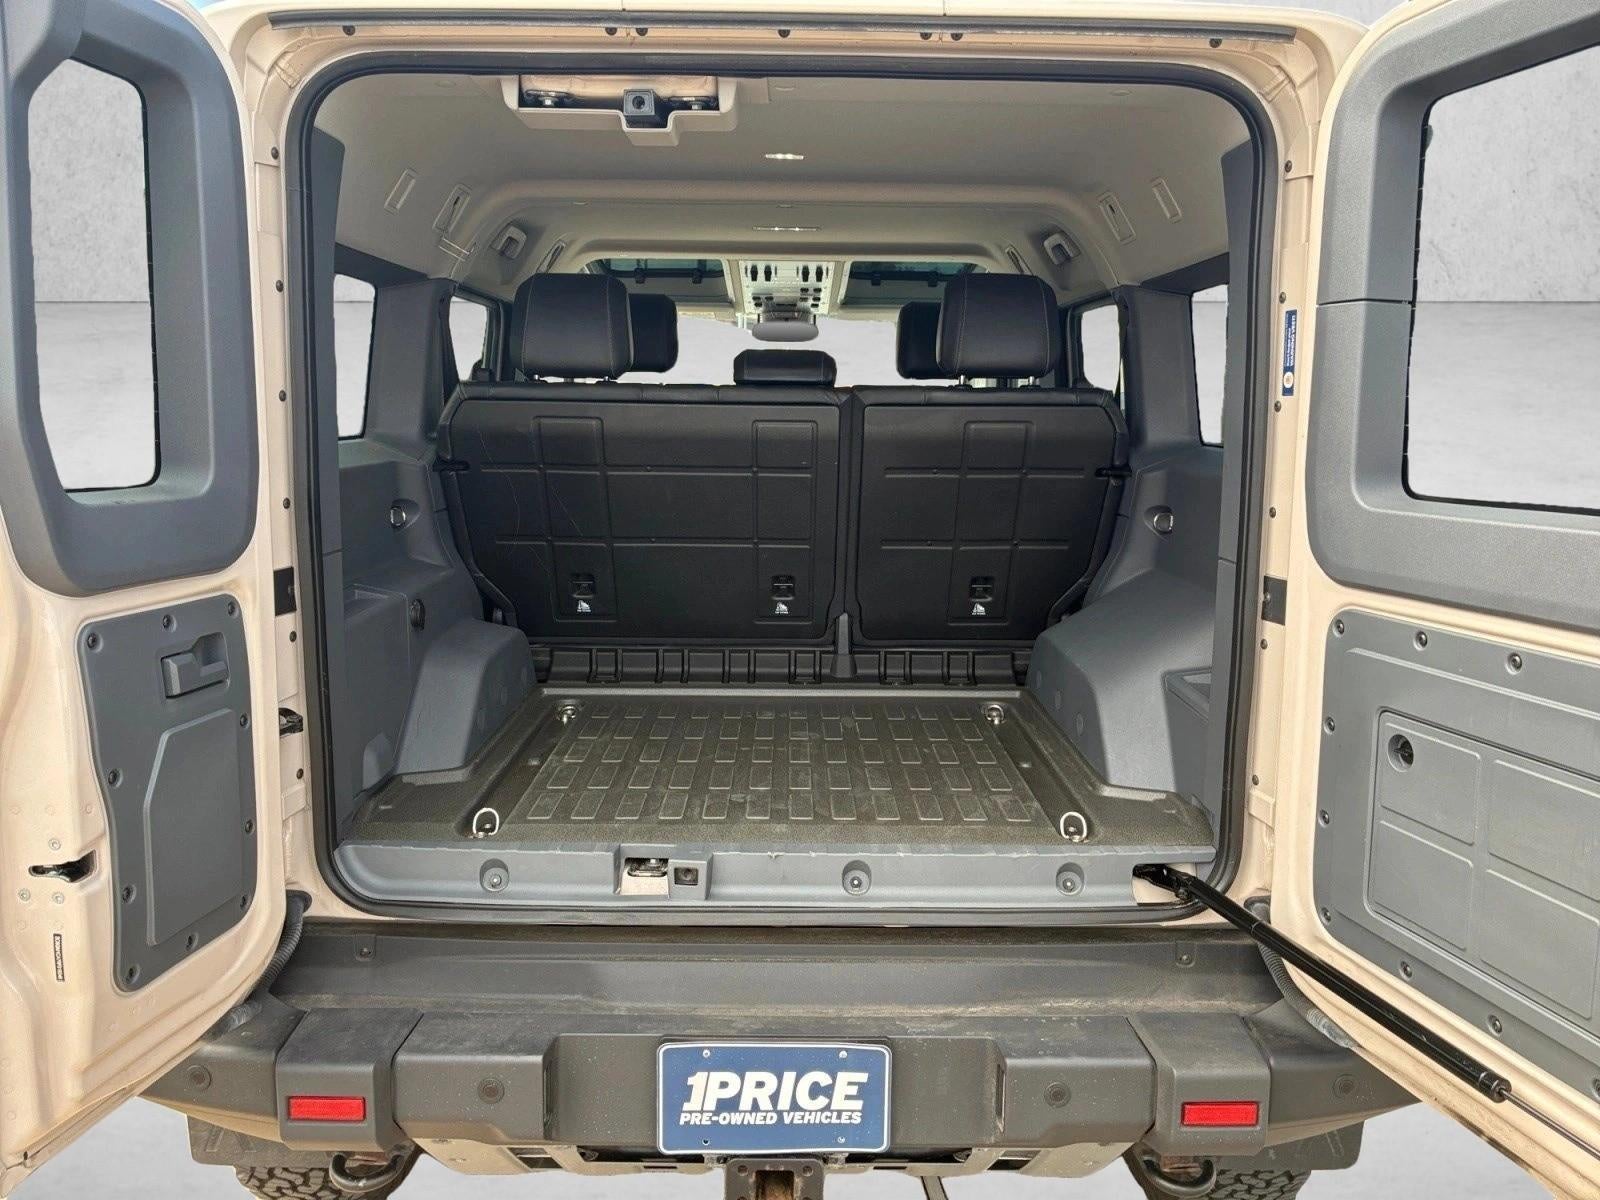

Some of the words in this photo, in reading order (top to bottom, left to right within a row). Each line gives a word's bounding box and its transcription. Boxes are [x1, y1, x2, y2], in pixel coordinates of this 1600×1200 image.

[682, 1071, 869, 1111] 1PRICE
[679, 1111, 777, 1125] PRE-OWNED
[783, 1111, 862, 1125] VEHICLES
